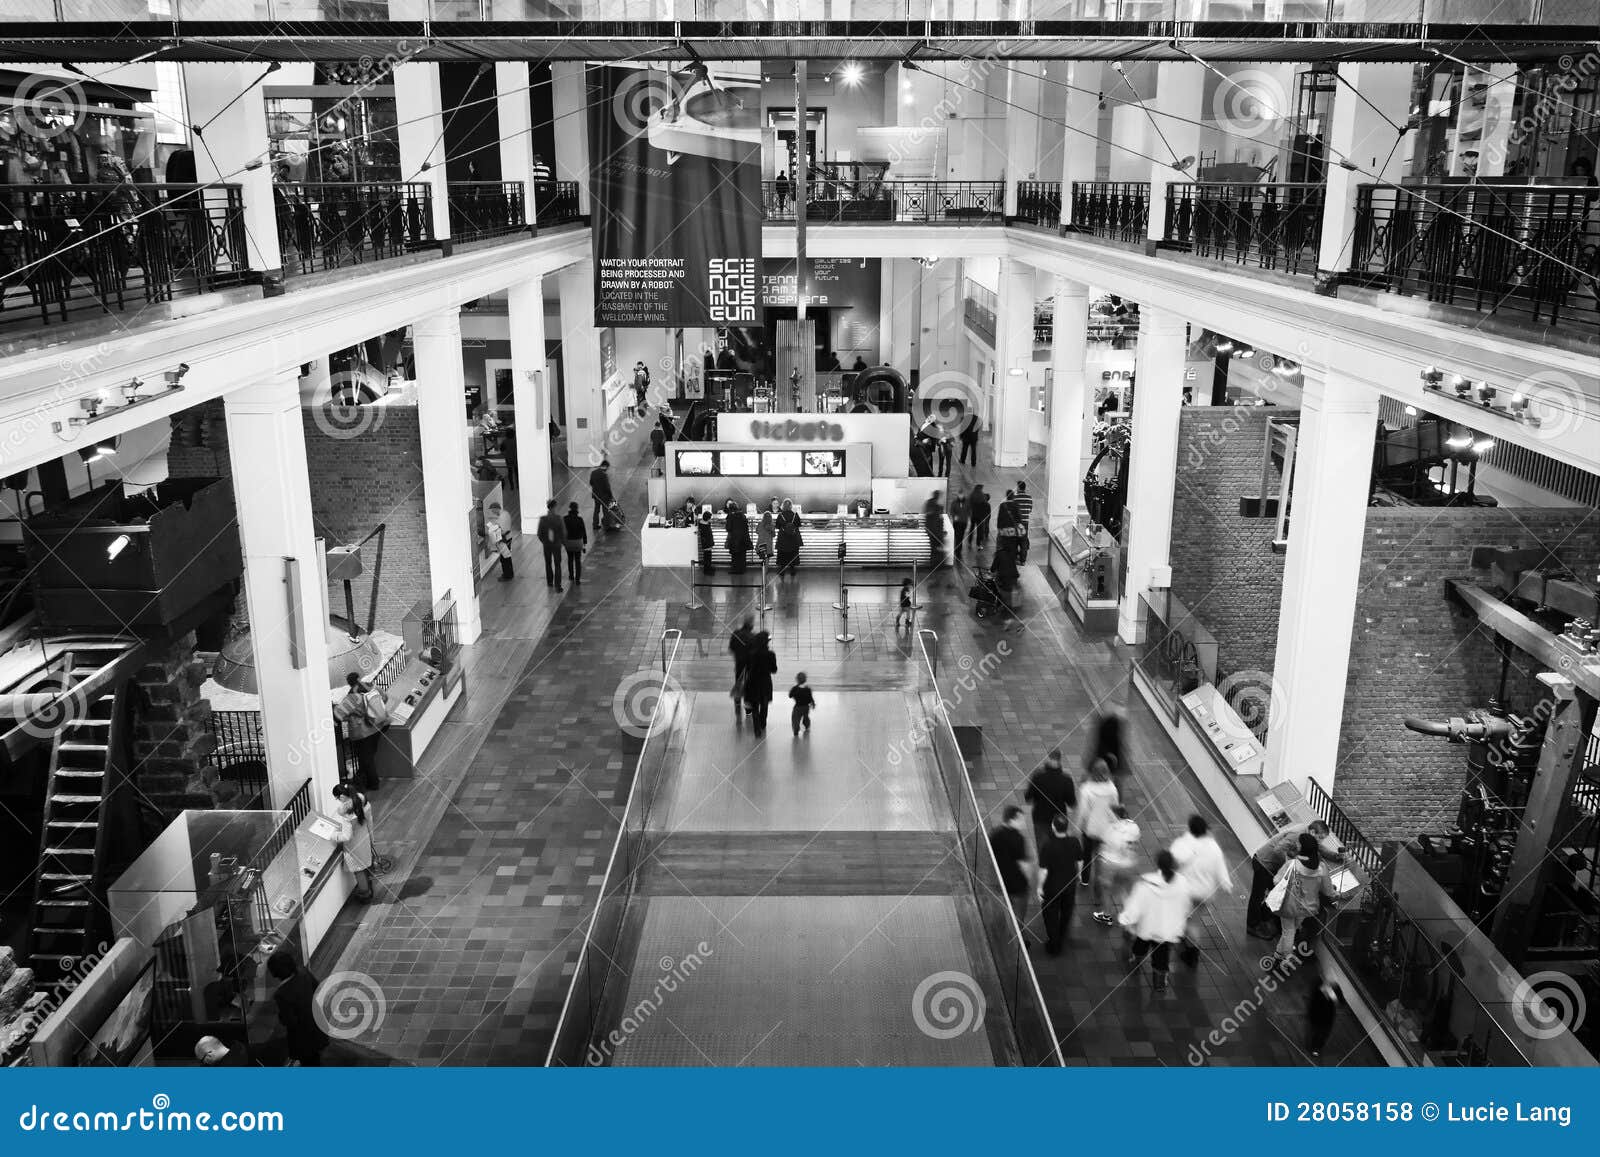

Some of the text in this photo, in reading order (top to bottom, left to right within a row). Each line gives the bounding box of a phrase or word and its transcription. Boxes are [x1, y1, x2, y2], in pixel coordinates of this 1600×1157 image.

[600, 258, 685, 267] WATCH YOUR PORTRAIT
[601, 269, 685, 278] BEING PROCESSED AND
[601, 280, 675, 289] DRAWN BY A ROBOT.
[601, 291, 660, 300] LOCATED IN THE
[602, 302, 669, 311] BASEMENT OF THE
[601, 313, 643, 321] WELLCOME
